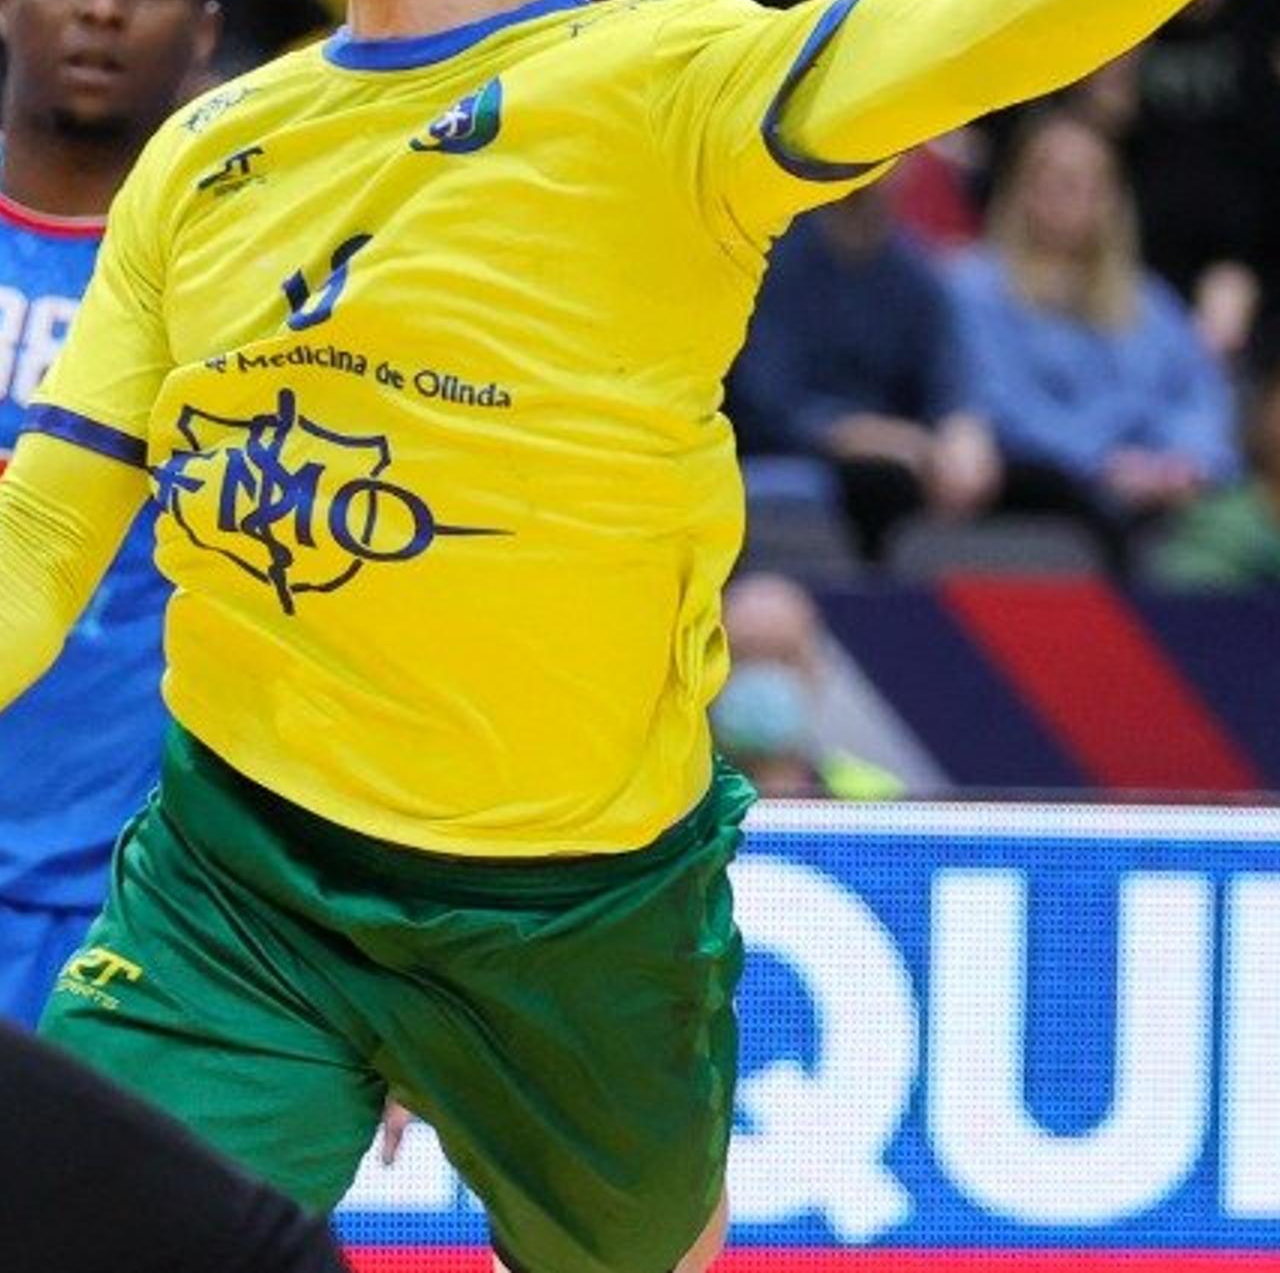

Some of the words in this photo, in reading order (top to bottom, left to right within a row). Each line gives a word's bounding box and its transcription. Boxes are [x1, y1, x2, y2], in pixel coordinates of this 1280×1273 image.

[237, 345, 369, 377] Medicina
[375, 360, 406, 391] de
[414, 369, 512, 408] Olinda
